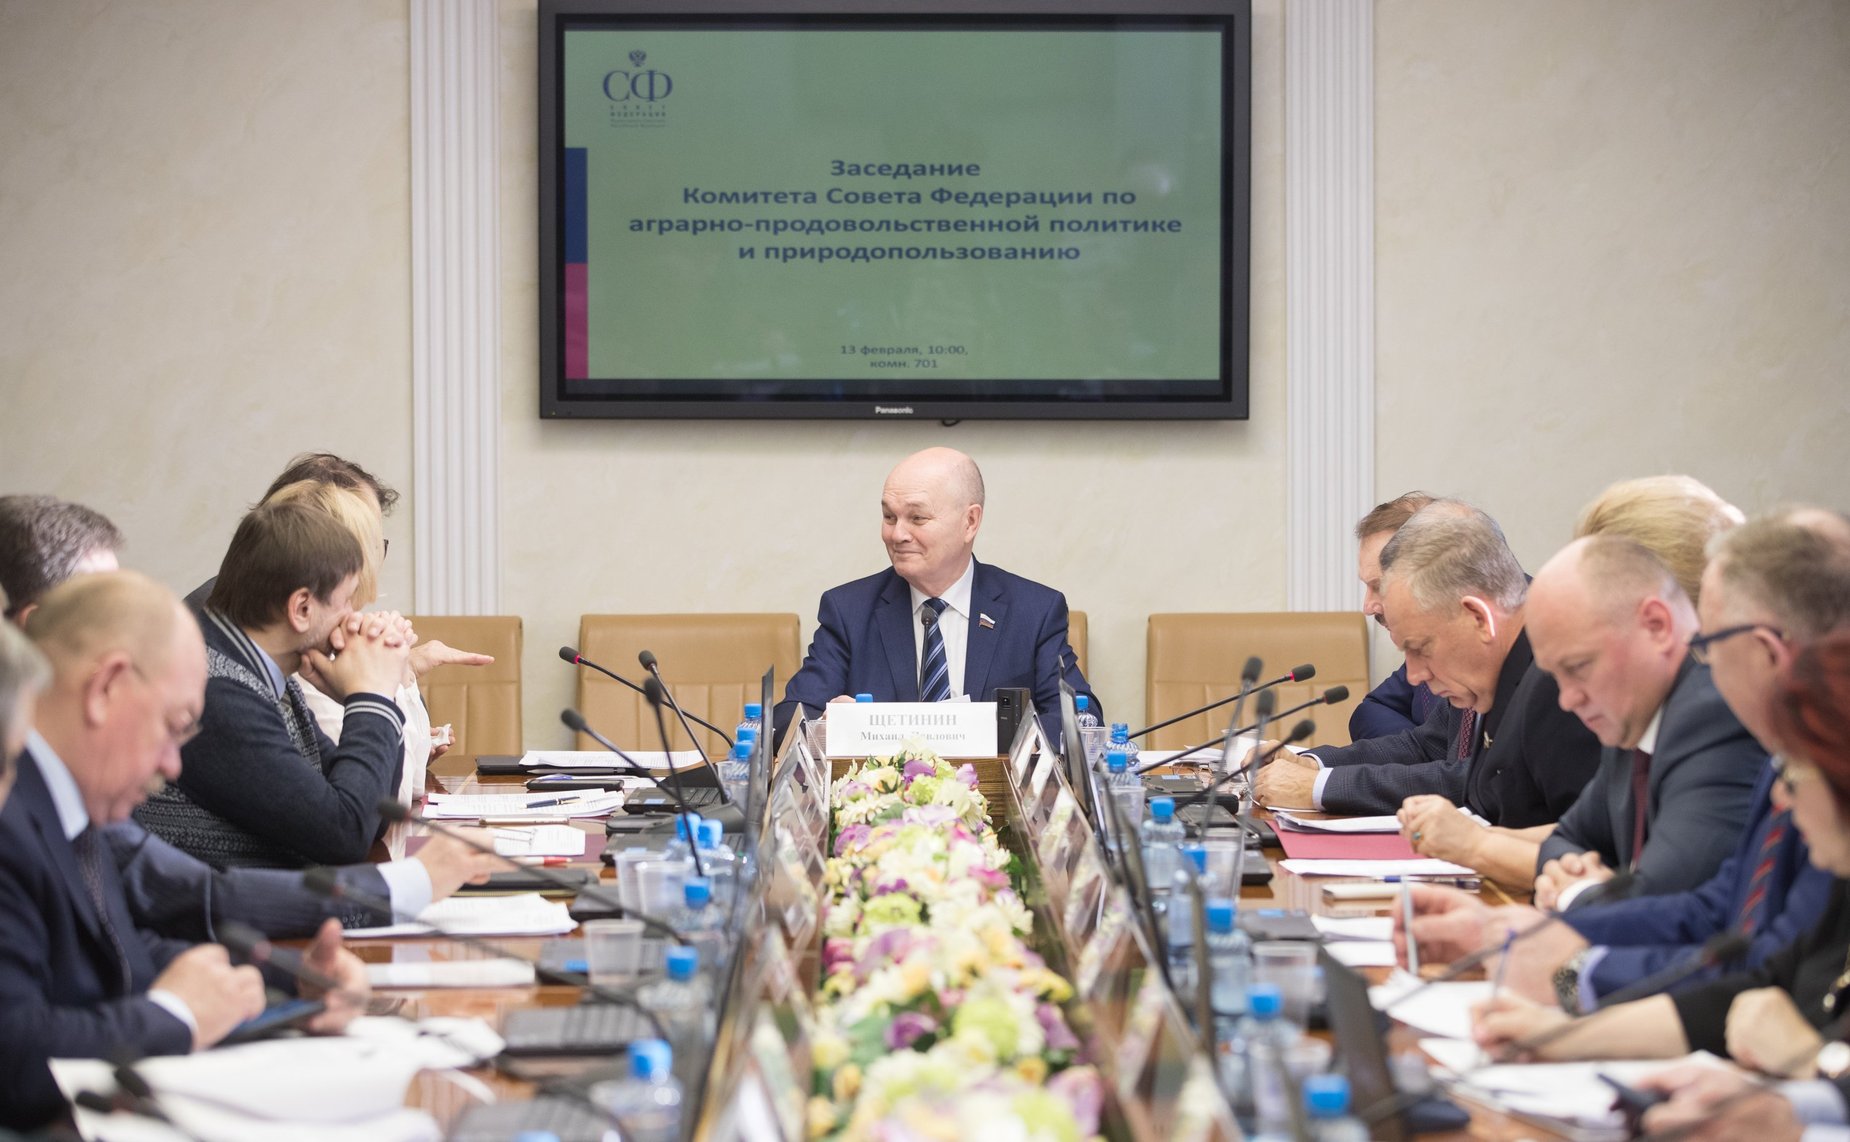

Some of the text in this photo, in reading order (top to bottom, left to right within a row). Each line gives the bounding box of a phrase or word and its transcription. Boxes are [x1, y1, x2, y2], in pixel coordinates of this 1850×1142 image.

[602, 69, 673, 102] СФ
[831, 159, 981, 179] Заседание
[683, 187, 1137, 208] Комитета Совета Федерации по
[629, 214, 1182, 235] аграрно-продовольственной политике
[738, 246, 1081, 263] и природопользованию
[841, 345, 968, 356] 13 февраля, 10:00,
[870, 359, 938, 369] комн. 701
[874, 405, 914, 415] Panasonic
[869, 714, 957, 727] ЩЕТИНИН
